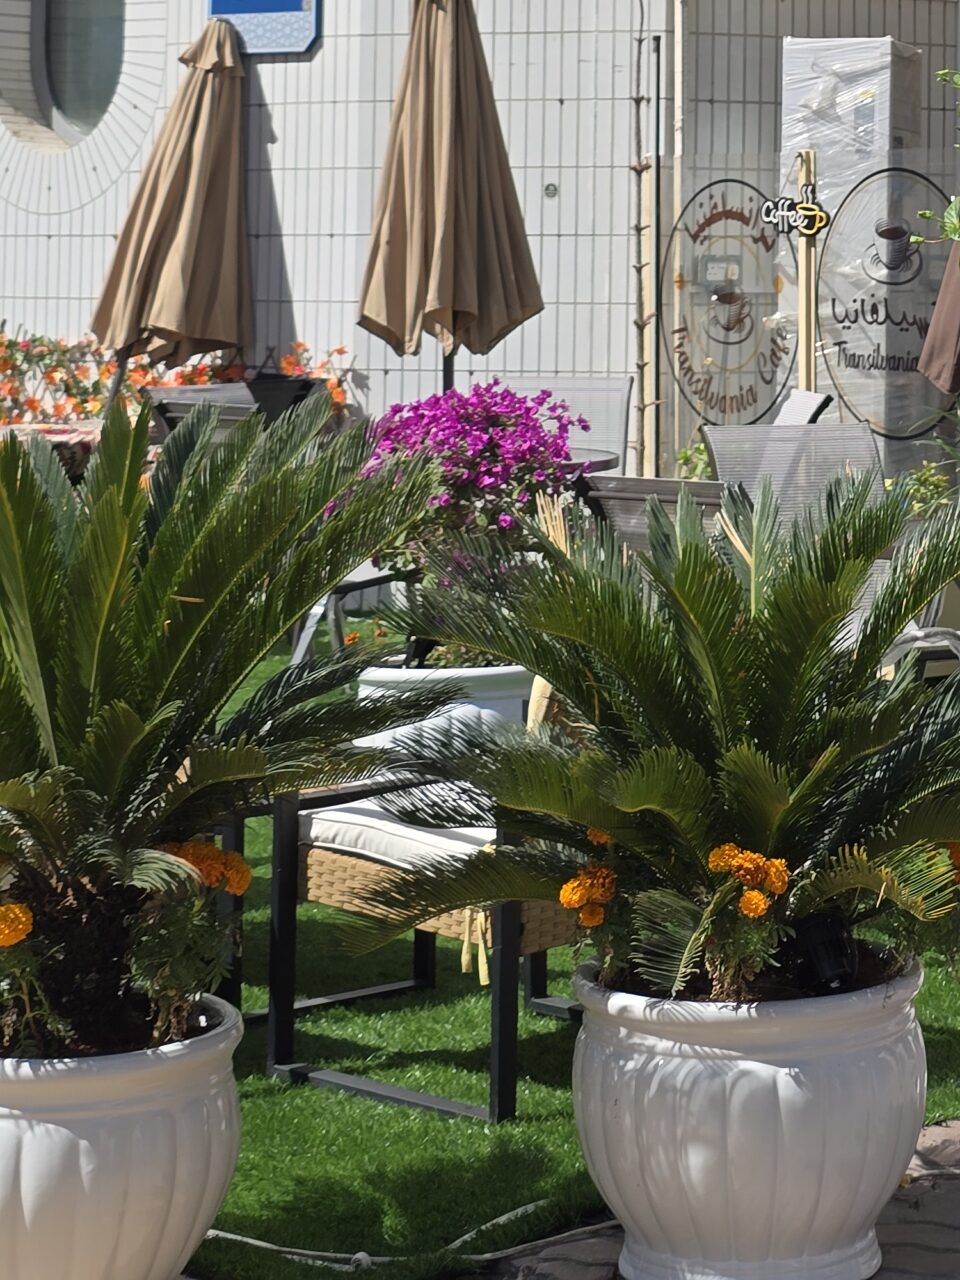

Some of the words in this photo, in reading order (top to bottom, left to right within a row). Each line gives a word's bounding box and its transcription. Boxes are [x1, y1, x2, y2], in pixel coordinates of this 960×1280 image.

[761, 198, 810, 234] Coffee
[671, 314, 758, 415] Transilvania
[833, 341, 921, 372] Transilvania
